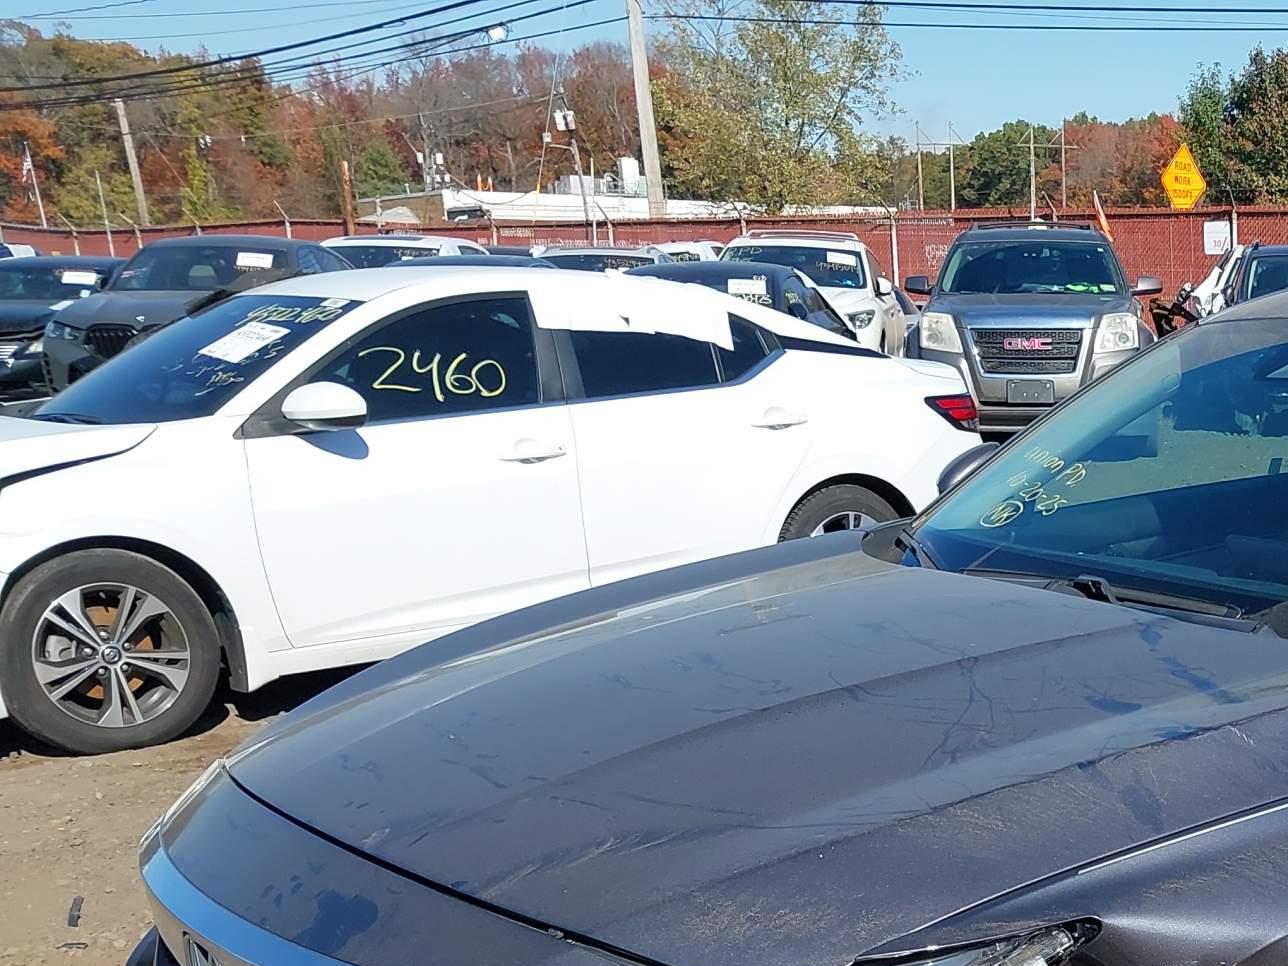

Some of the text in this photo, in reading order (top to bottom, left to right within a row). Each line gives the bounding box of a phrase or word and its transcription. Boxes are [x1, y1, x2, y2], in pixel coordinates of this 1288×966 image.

[1175, 161, 1192, 172] ROAD
[1174, 175, 1192, 186] WORK
[1003, 337, 1053, 350] GMC
[358, 346, 507, 403] 2460
[1007, 470, 1068, 516] 10-20-25
